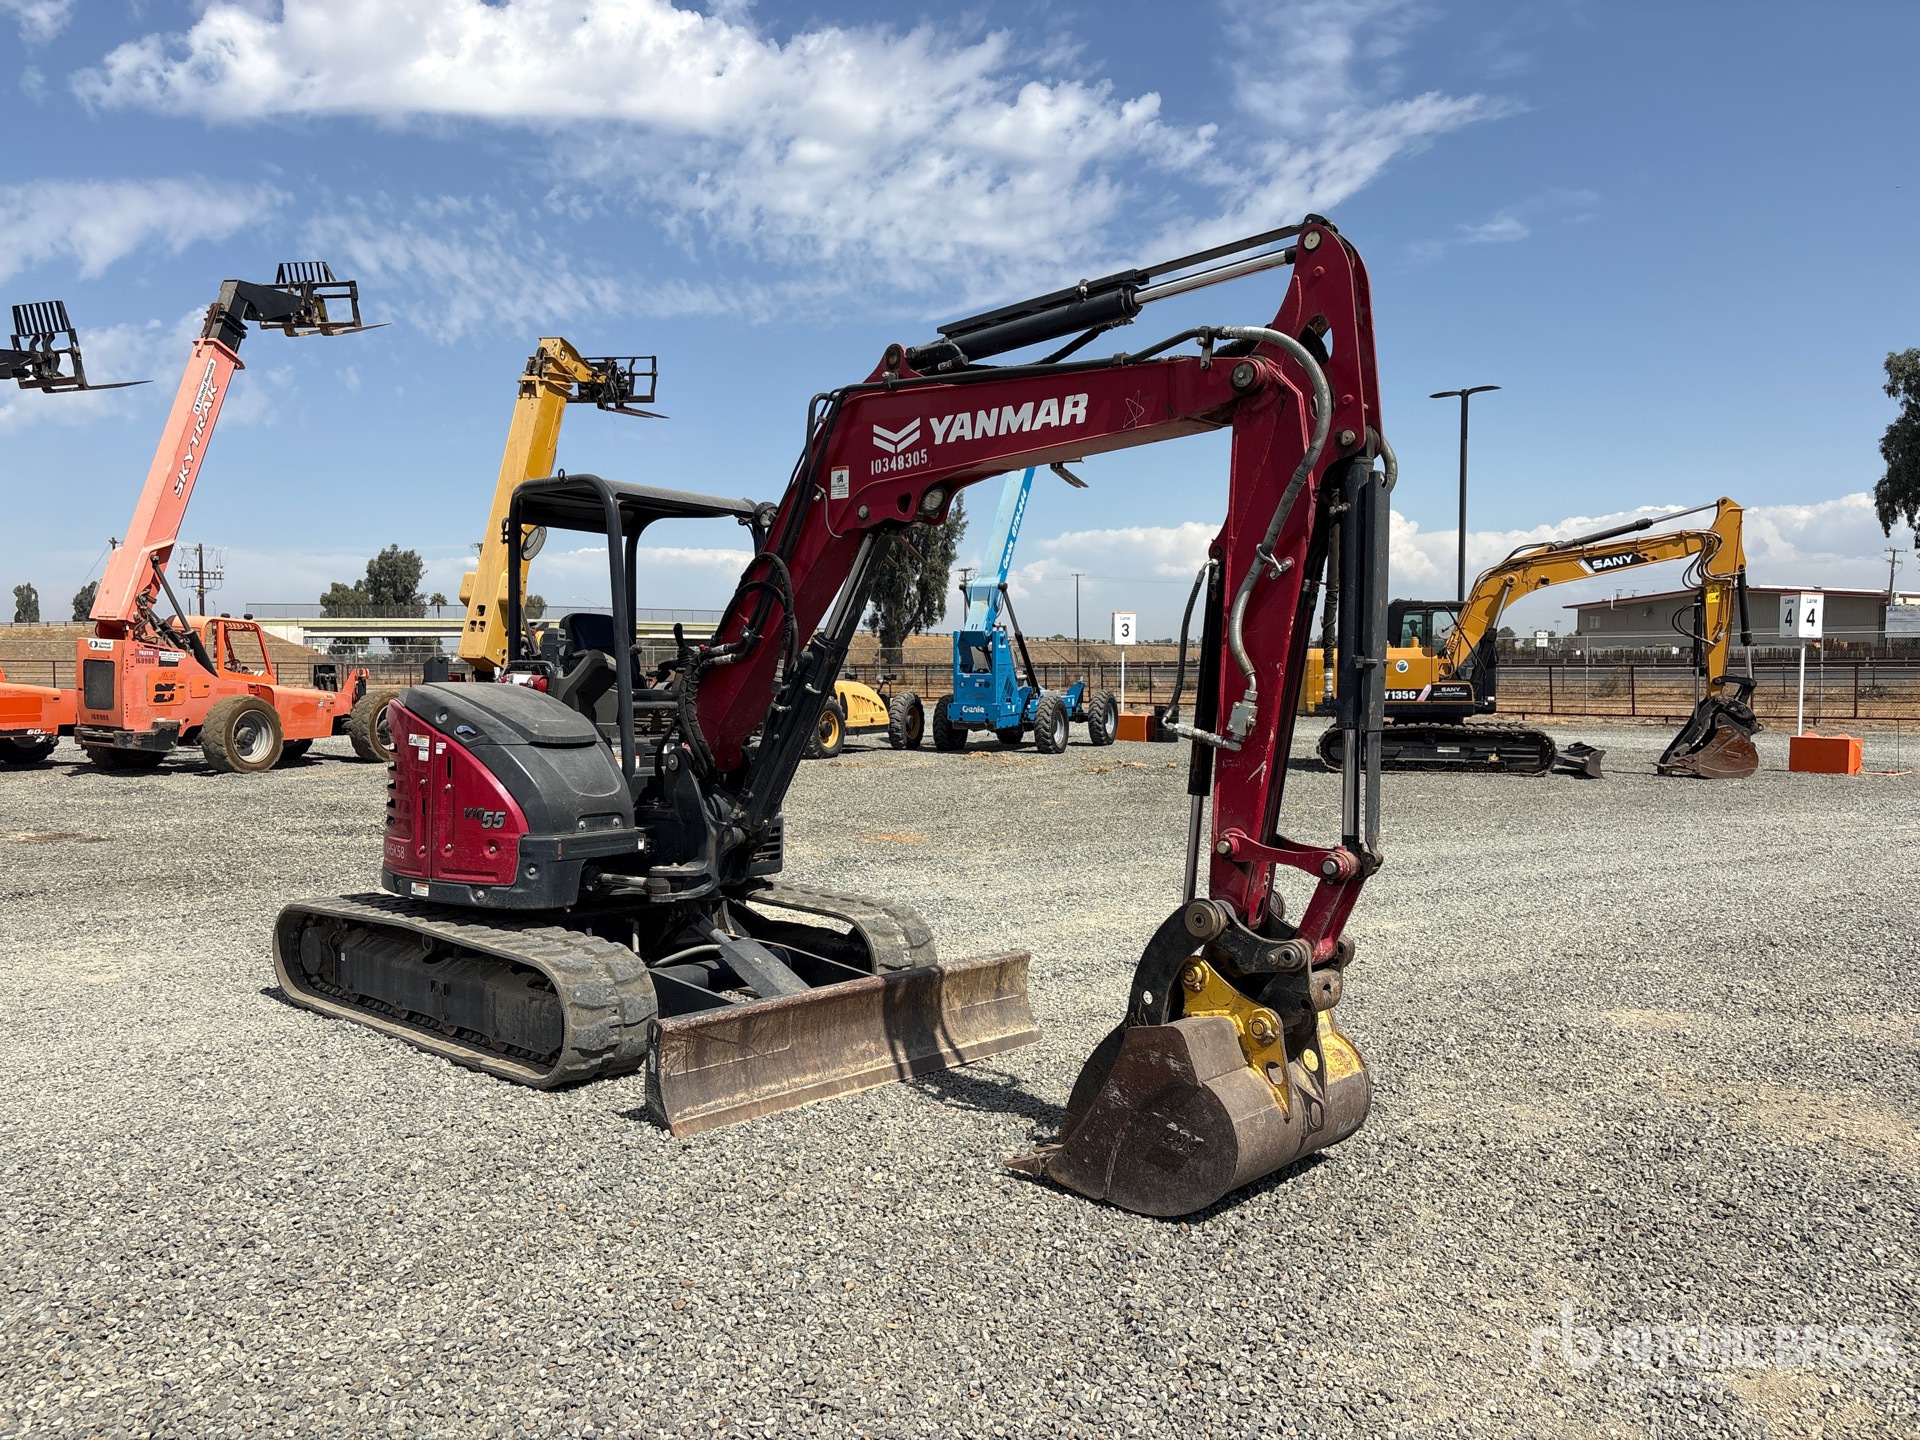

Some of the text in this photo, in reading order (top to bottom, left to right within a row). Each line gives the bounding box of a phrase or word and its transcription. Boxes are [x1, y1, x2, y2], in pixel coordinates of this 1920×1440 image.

[929, 393, 1089, 445] YANMAR
[173, 376, 219, 499] SKYTRAK
[871, 449, 928, 475] 10348305
[1592, 554, 1633, 570] SANY
[1785, 607, 1793, 627] 4
[1806, 607, 1815, 627] 4
[1121, 623, 1130, 637] 3
[962, 705, 985, 713] Genie
